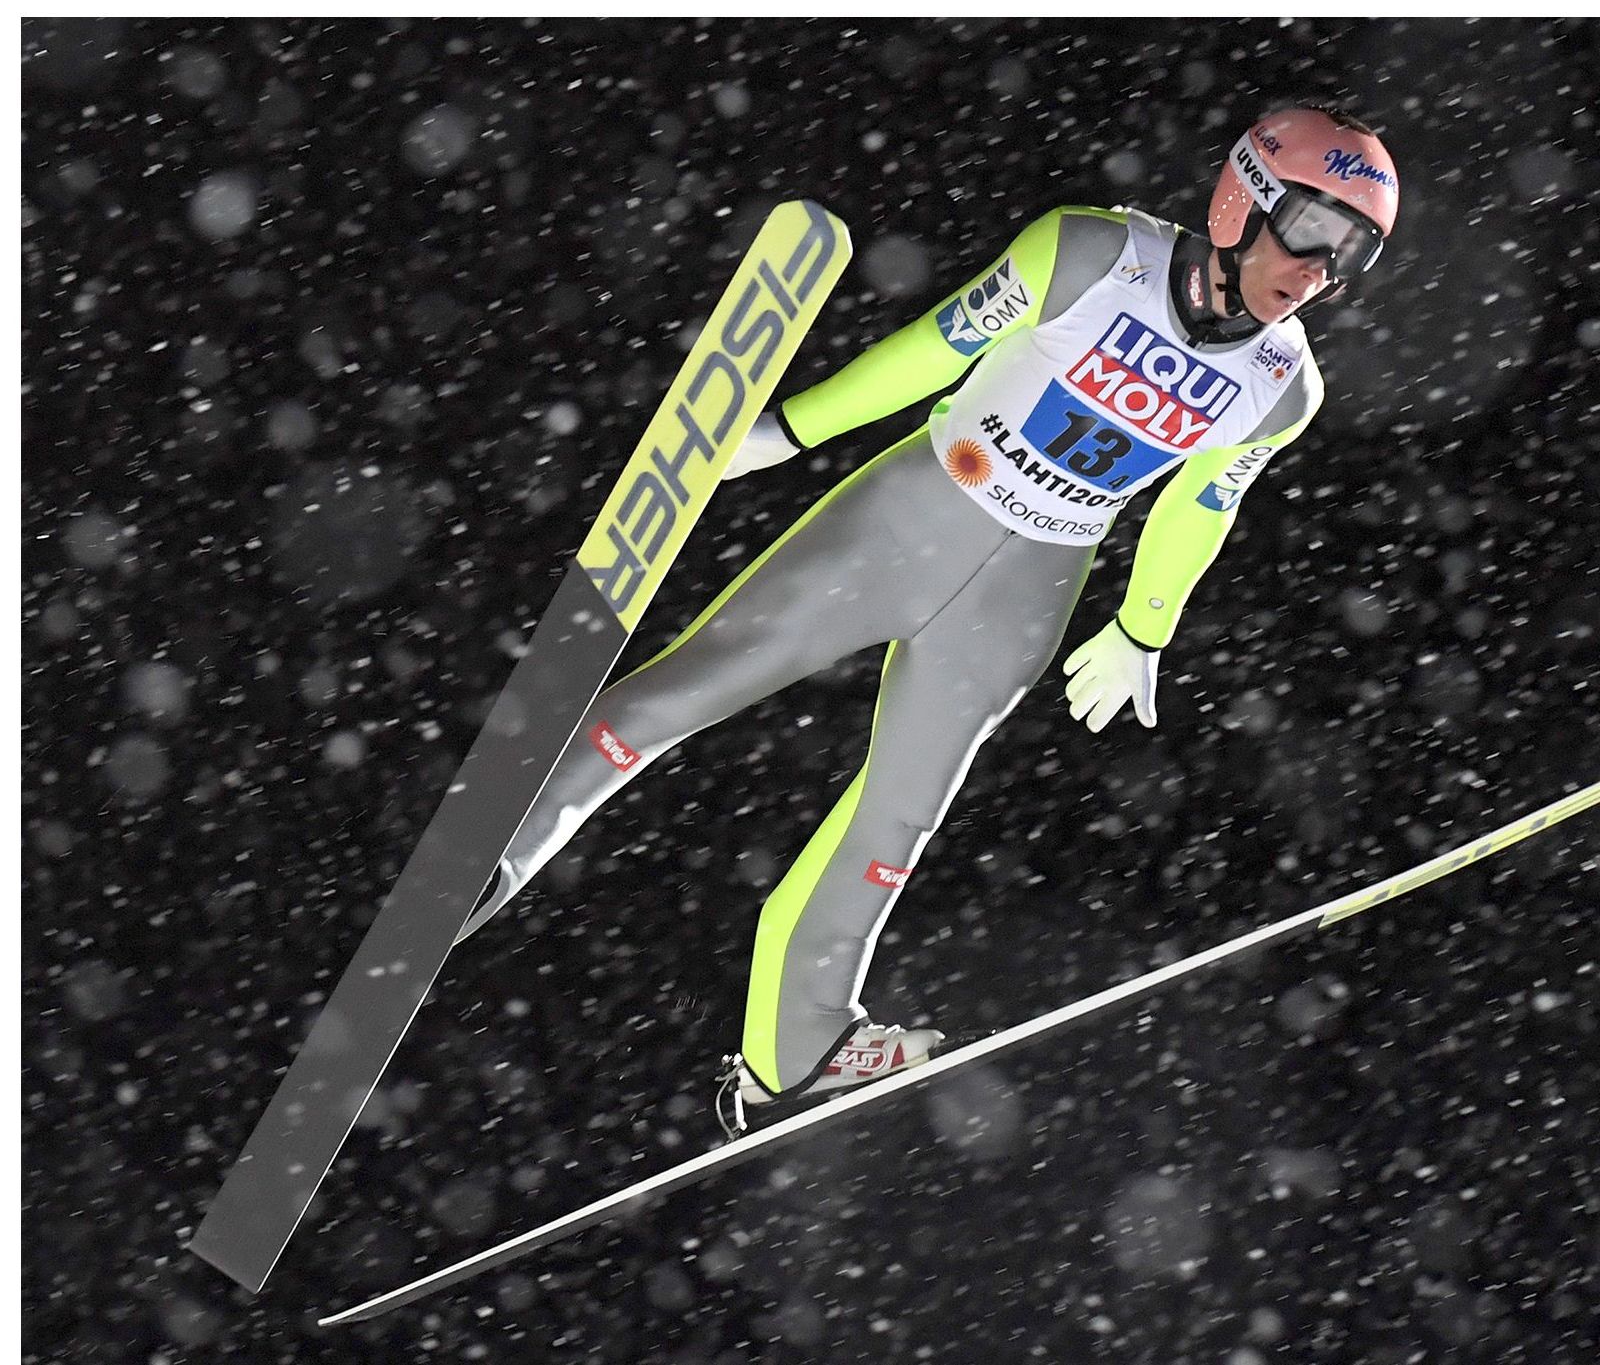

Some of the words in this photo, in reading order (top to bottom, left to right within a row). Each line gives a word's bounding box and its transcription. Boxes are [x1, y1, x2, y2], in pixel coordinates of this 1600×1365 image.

[1255, 126, 1282, 156] uvex
[1237, 147, 1275, 201] uvex
[982, 292, 1030, 332] OMV
[1101, 318, 1238, 417] LIQUI
[1254, 352, 1277, 372] 2017
[1260, 341, 1293, 370] LAHTI
[585, 199, 837, 613] FISCHER
[1071, 359, 1211, 447] MOLY
[1043, 410, 1132, 477] 13
[1225, 446, 1273, 484] OMV
[987, 484, 1104, 536] storaenso
